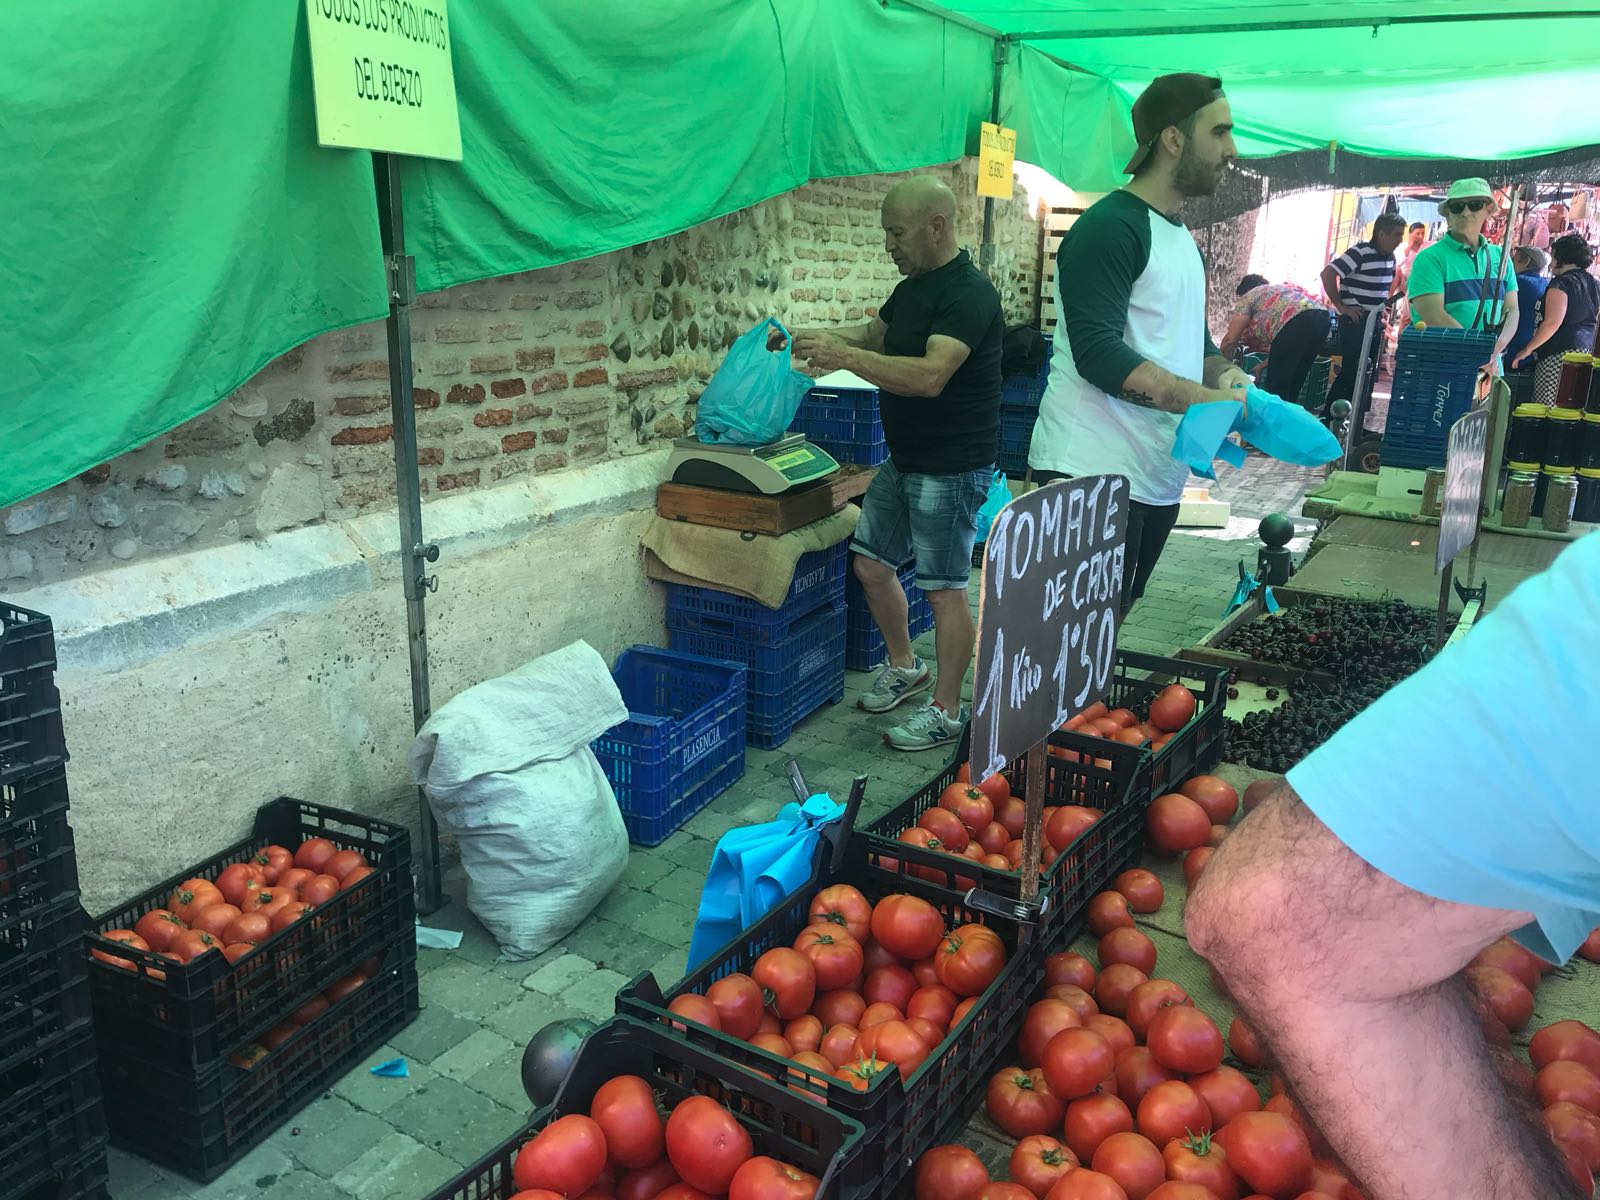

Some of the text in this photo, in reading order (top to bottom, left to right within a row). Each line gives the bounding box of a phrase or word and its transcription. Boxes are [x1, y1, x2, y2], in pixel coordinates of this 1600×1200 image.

[363, 0, 388, 33] LOS
[388, 0, 446, 51] PRODUCTOS
[354, 57, 422, 108] DEL BIERZO
[989, 475, 1123, 600] TOMATE
[1043, 543, 1125, 622] DE CASA
[976, 627, 1006, 782] 1
[683, 725, 721, 766] PLASENCIA
